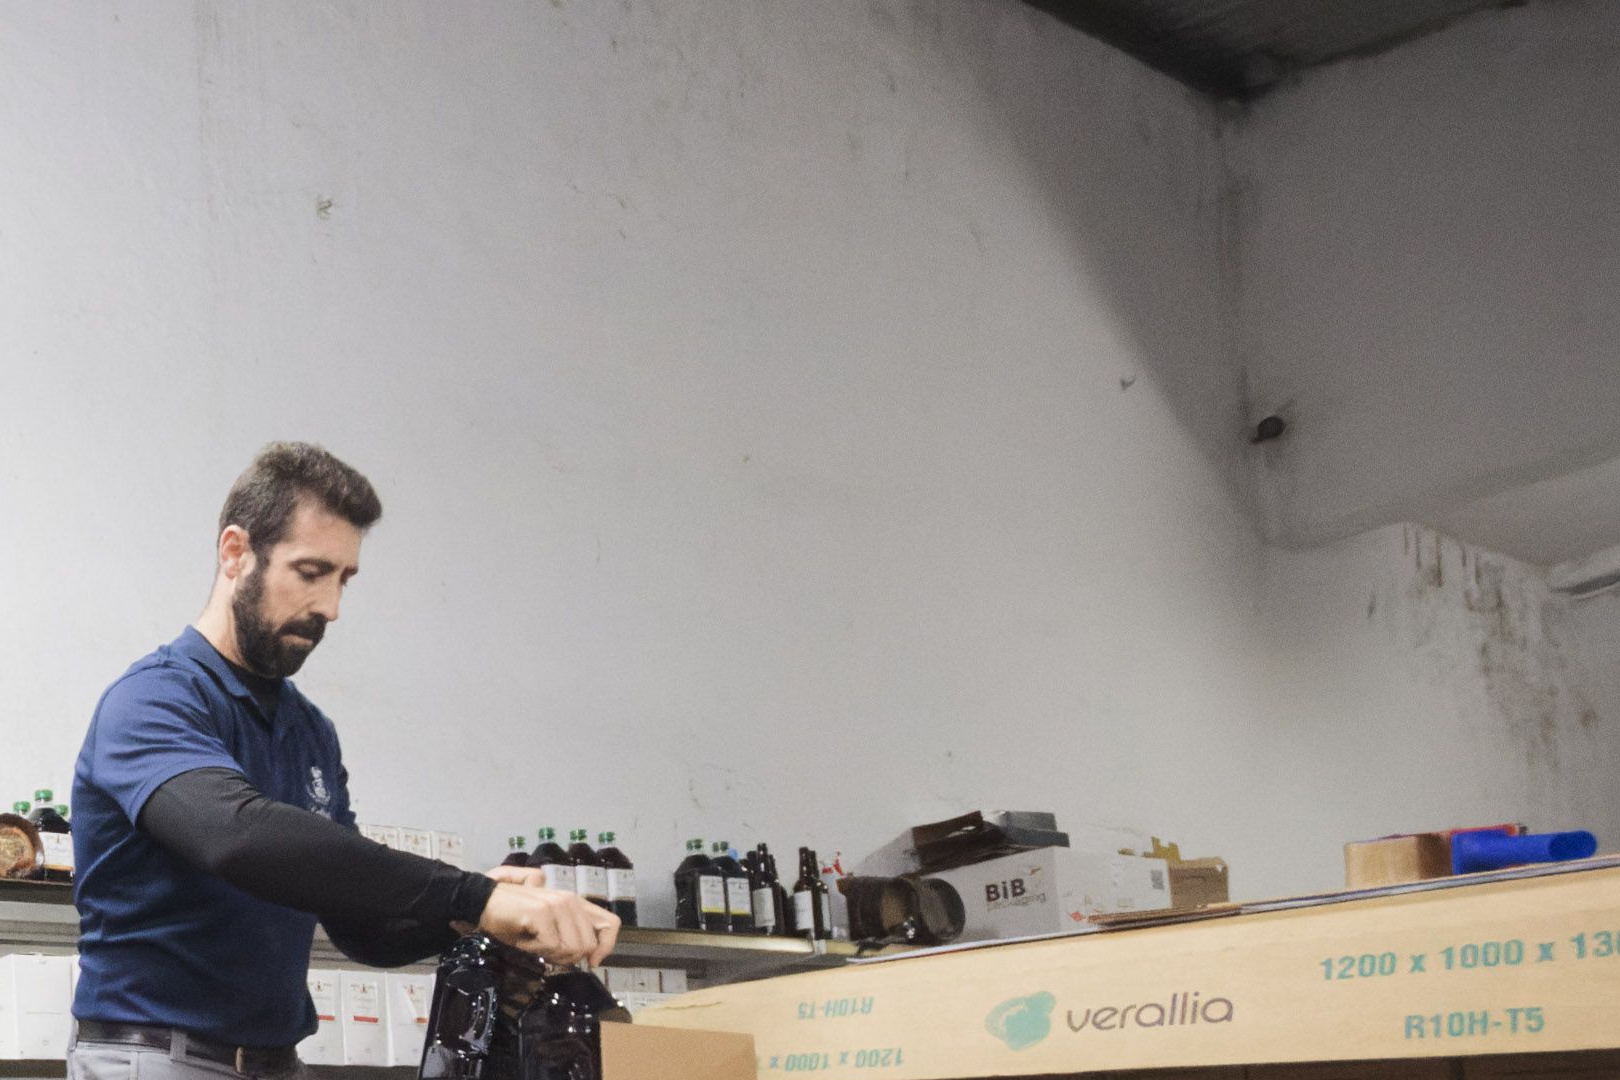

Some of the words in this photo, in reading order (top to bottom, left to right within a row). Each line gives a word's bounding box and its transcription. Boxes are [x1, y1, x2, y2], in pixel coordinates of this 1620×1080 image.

[985, 878, 1027, 903] BiB
[1320, 951, 1397, 981] 1200
[1409, 953, 1426, 974] x
[1439, 938, 1525, 971] 1000
[1537, 941, 1556, 962] x
[1569, 929, 1620, 960] 13
[1066, 991, 1235, 1033] verallia
[1403, 1006, 1546, 1040] R10H-T5
[784, 1052, 830, 1072] 1000
[854, 1047, 904, 1068] 1200
